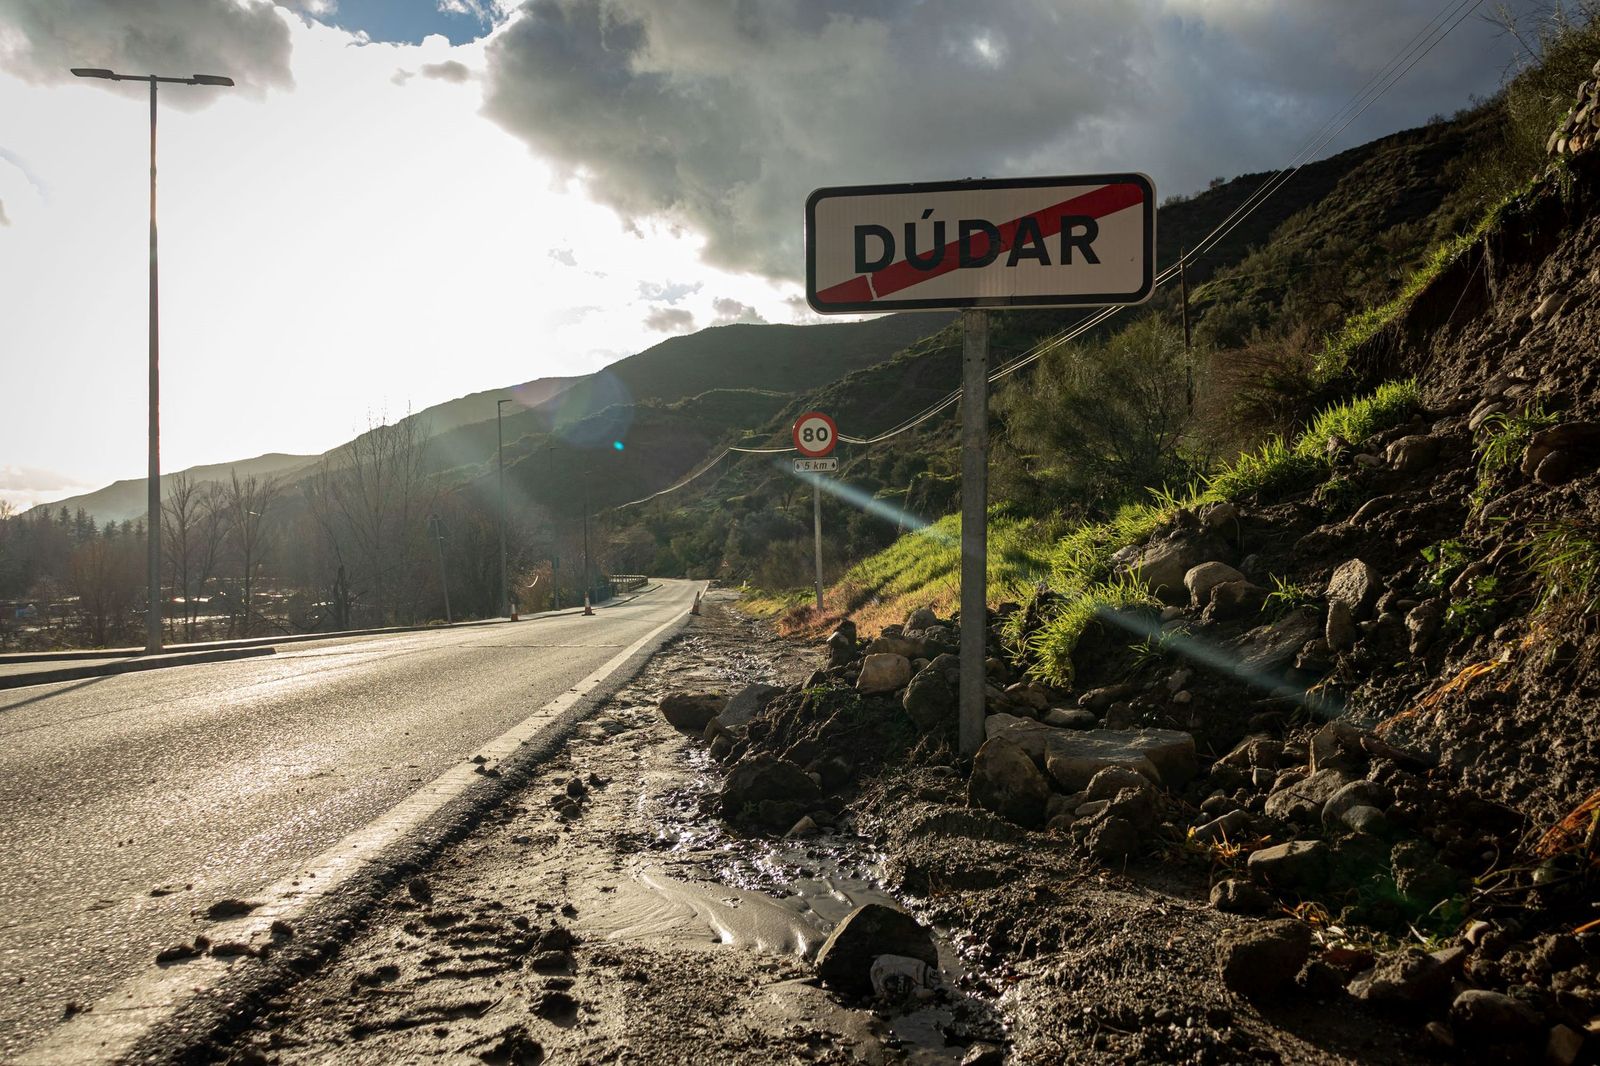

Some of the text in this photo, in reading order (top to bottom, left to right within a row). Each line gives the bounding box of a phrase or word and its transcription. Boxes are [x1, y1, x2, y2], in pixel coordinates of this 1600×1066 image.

[854, 208, 1101, 274] DÚDAR
[803, 427, 828, 442] 80
[804, 461, 828, 470] 5 km
